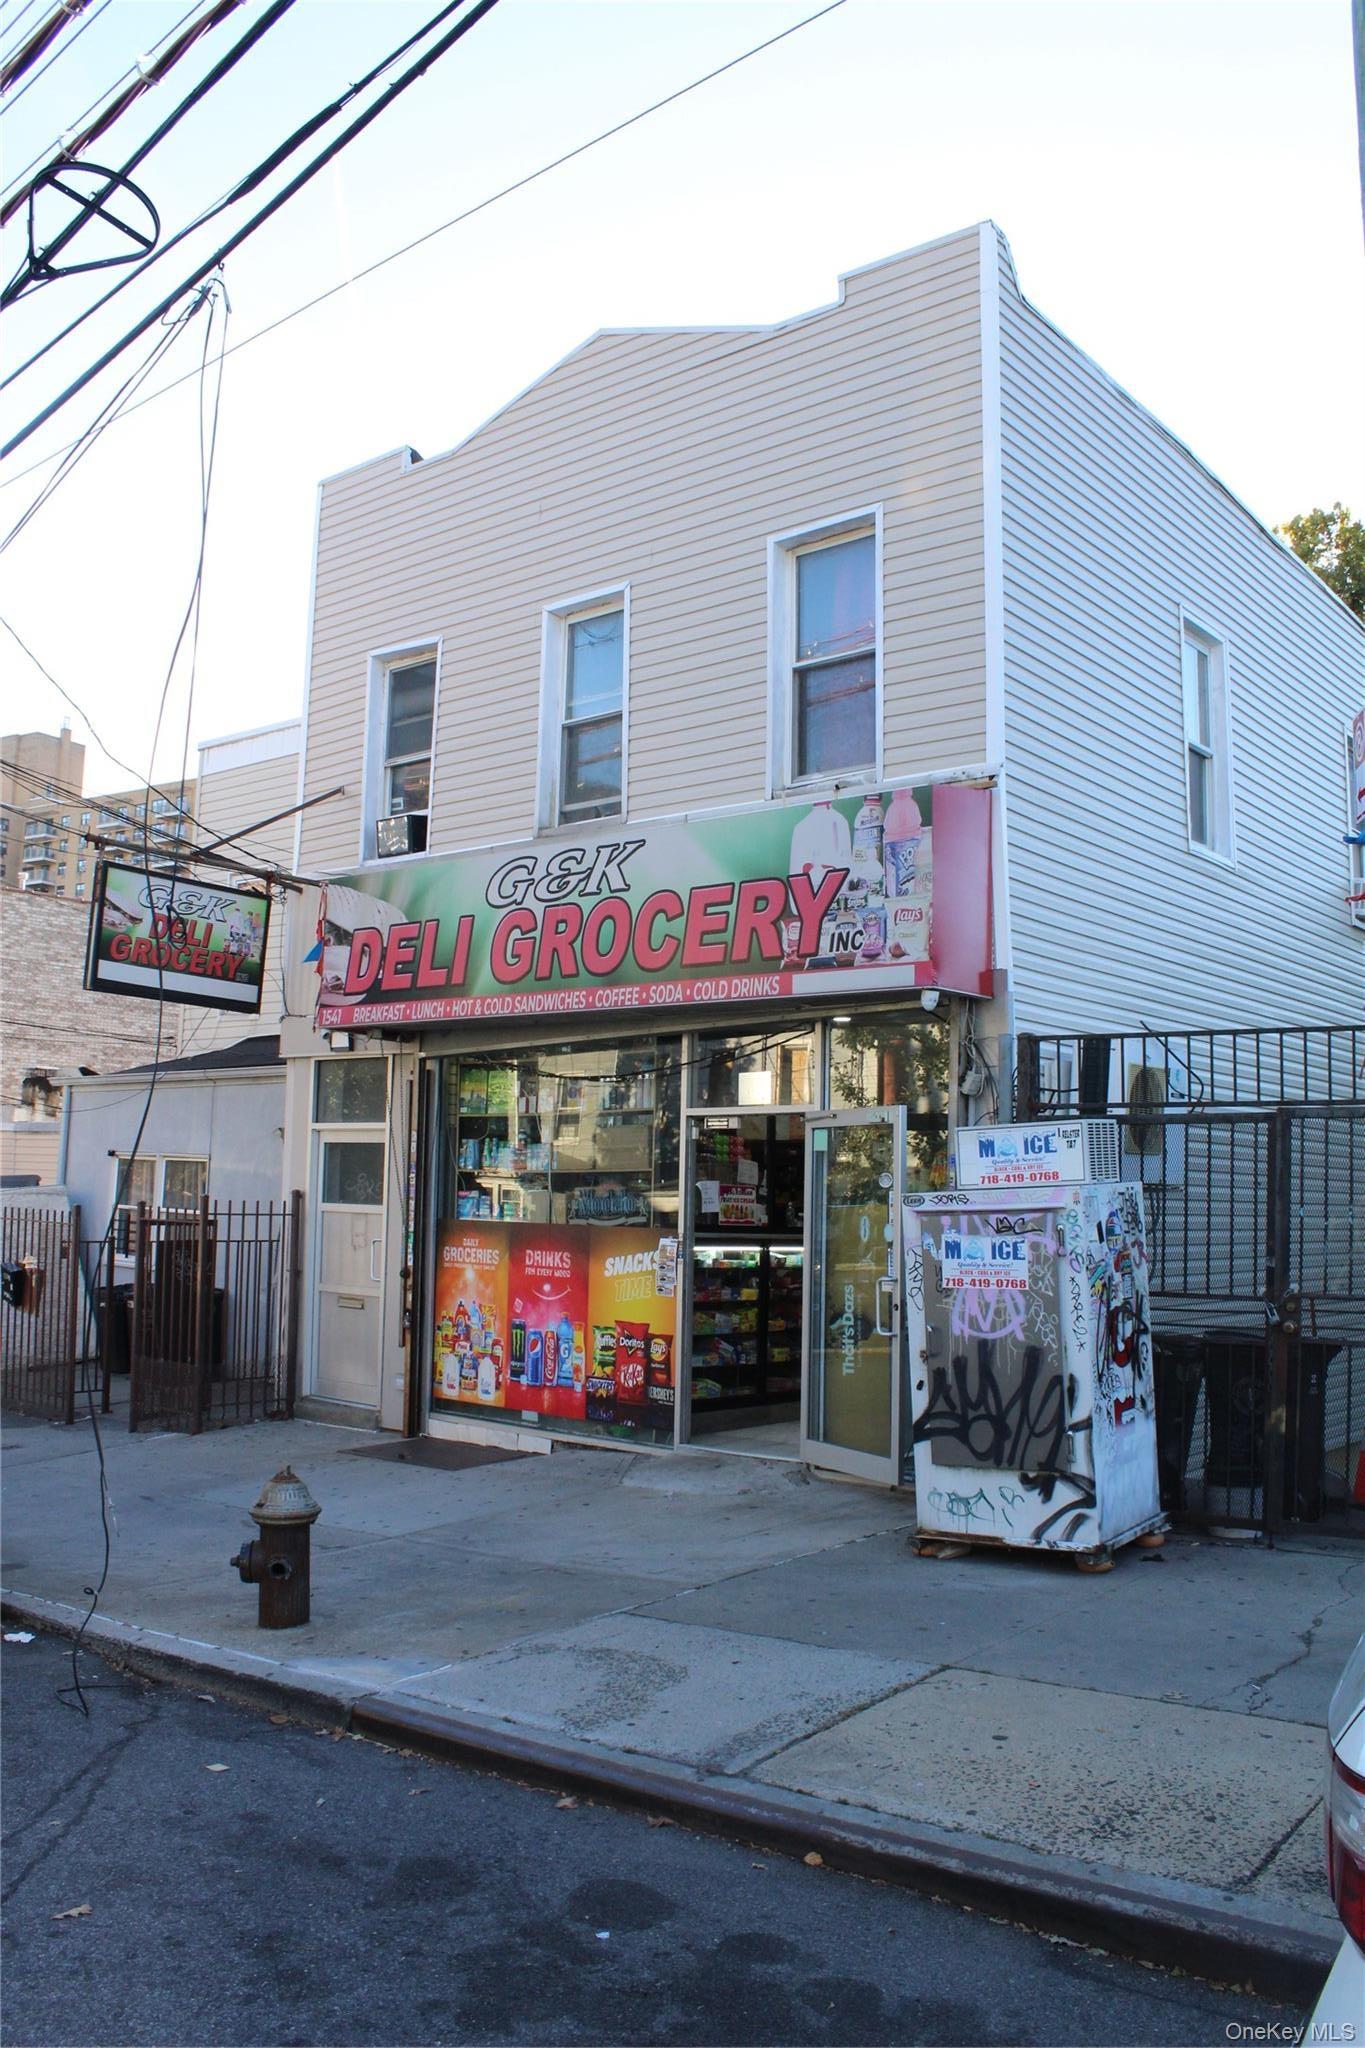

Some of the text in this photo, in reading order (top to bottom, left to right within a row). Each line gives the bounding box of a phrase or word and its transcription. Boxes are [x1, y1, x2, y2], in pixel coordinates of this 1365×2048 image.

[485, 838, 647, 909] G&K
[138, 884, 236, 923] G&K
[148, 912, 214, 948] DELI
[343, 867, 852, 996] DELI GROCERY
[829, 929, 864, 953] INC
[109, 933, 245, 980] GROCERY
[321, 975, 780, 1025] 1541 BREAKFAST LUNCH HOT & COLD SANDWICHES COFFEE SODA COLD DRINKS
[1023, 1130, 1058, 1156] ICE
[980, 1170, 1060, 1185] 718-419-0768
[443, 1246, 500, 1265] GROCERIES
[525, 1249, 572, 1269] DRINKS
[991, 1239, 1026, 1261] ICE
[524, 1267, 571, 1278] FOR EVERY MOOD
[956, 1261, 981, 1269] Quality
[614, 1275, 653, 1303] TIME
[943, 1277, 1027, 1289] 718-419-0768
[620, 1336, 645, 1349] Doritos
